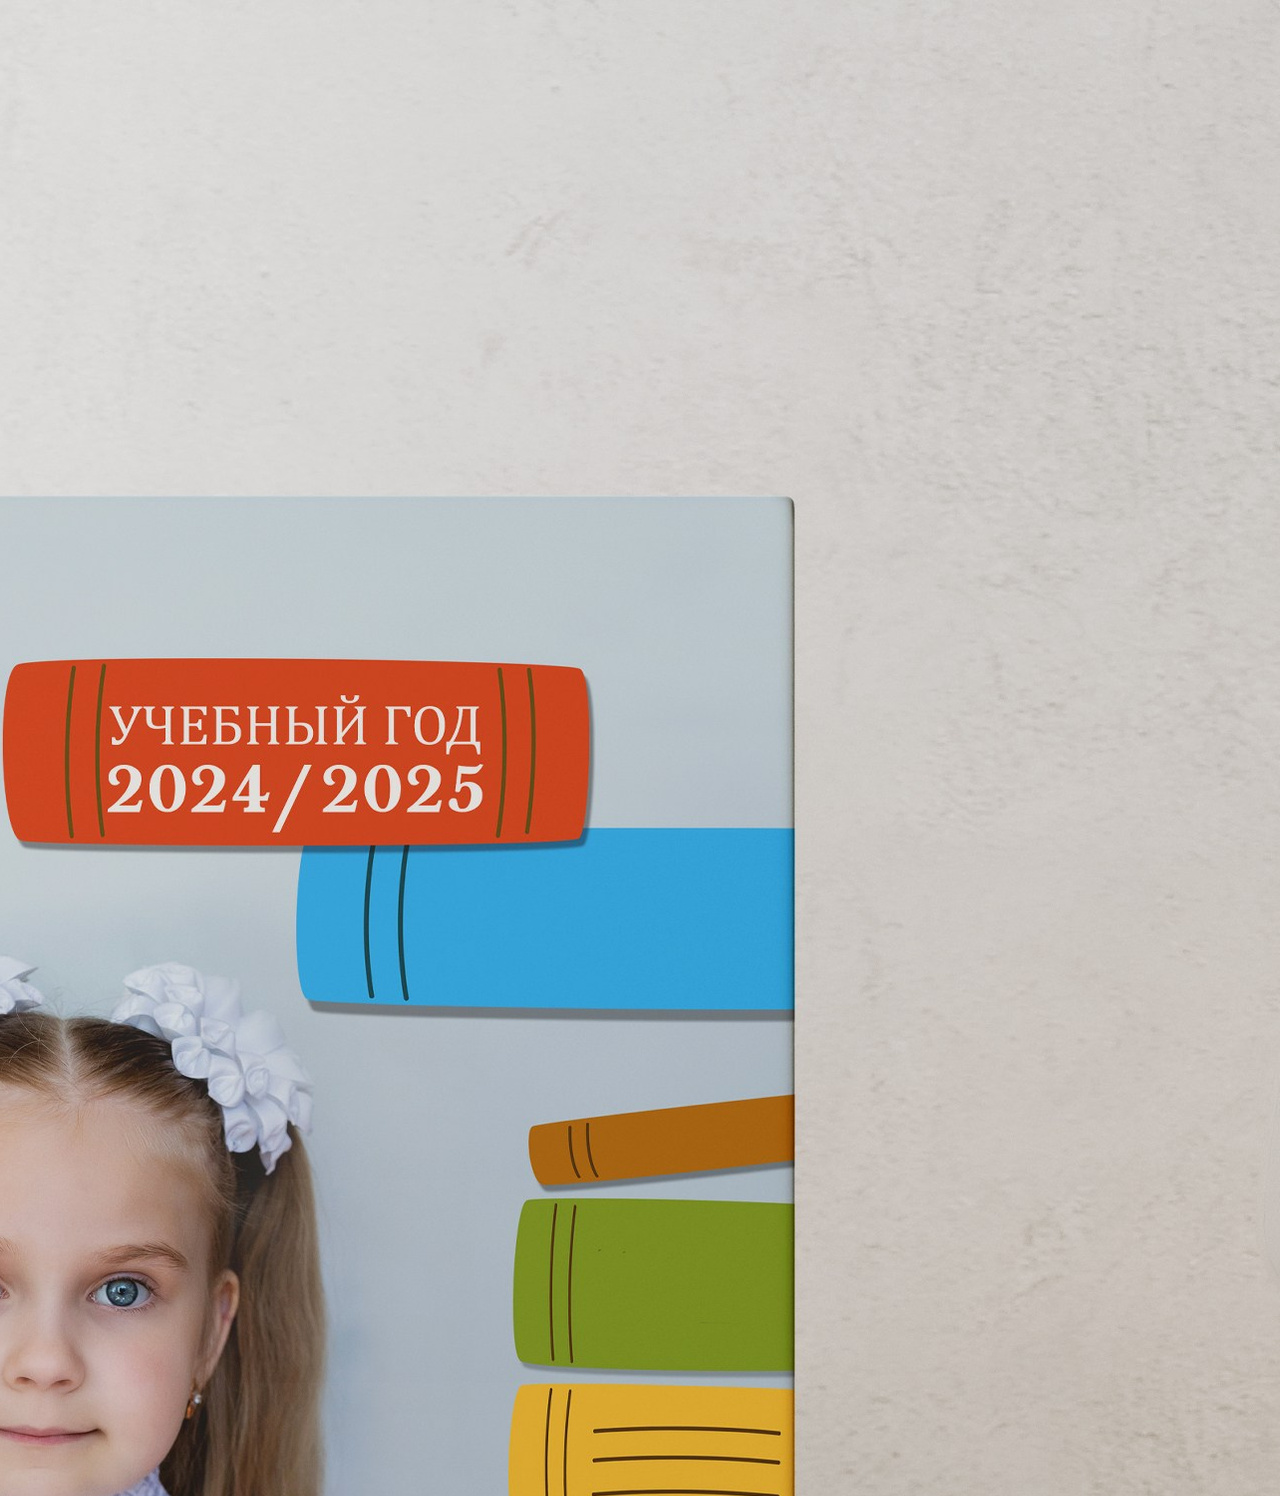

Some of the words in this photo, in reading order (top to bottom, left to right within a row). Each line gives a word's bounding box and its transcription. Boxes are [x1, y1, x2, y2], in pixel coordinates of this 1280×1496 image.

[109, 694, 367, 746] УЧЕБНЫЙ
[384, 705, 481, 756] ГОД
[107, 763, 484, 834] 2024/2025
